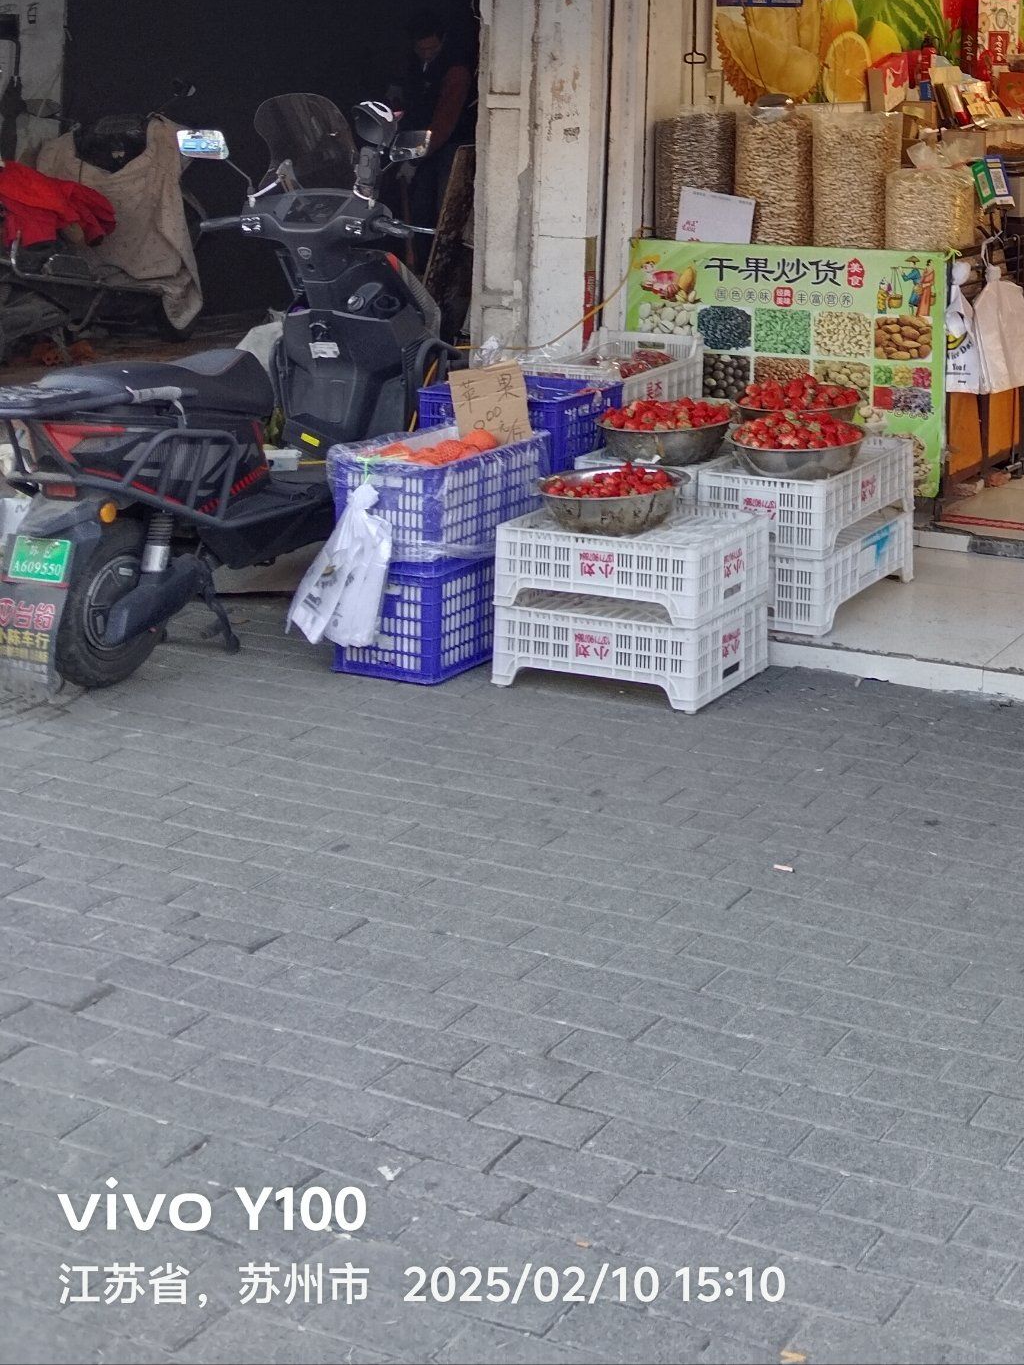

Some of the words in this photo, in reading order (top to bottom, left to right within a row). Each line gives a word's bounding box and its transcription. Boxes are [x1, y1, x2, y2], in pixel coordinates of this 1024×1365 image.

[704, 257, 846, 287] 干果炒货
[848, 261, 864, 287] 美食
[797, 290, 853, 306] 丰富营养
[459, 374, 520, 413] 苹果
[580, 562, 615, 579] 小刘
[575, 642, 610, 660] 小刘
